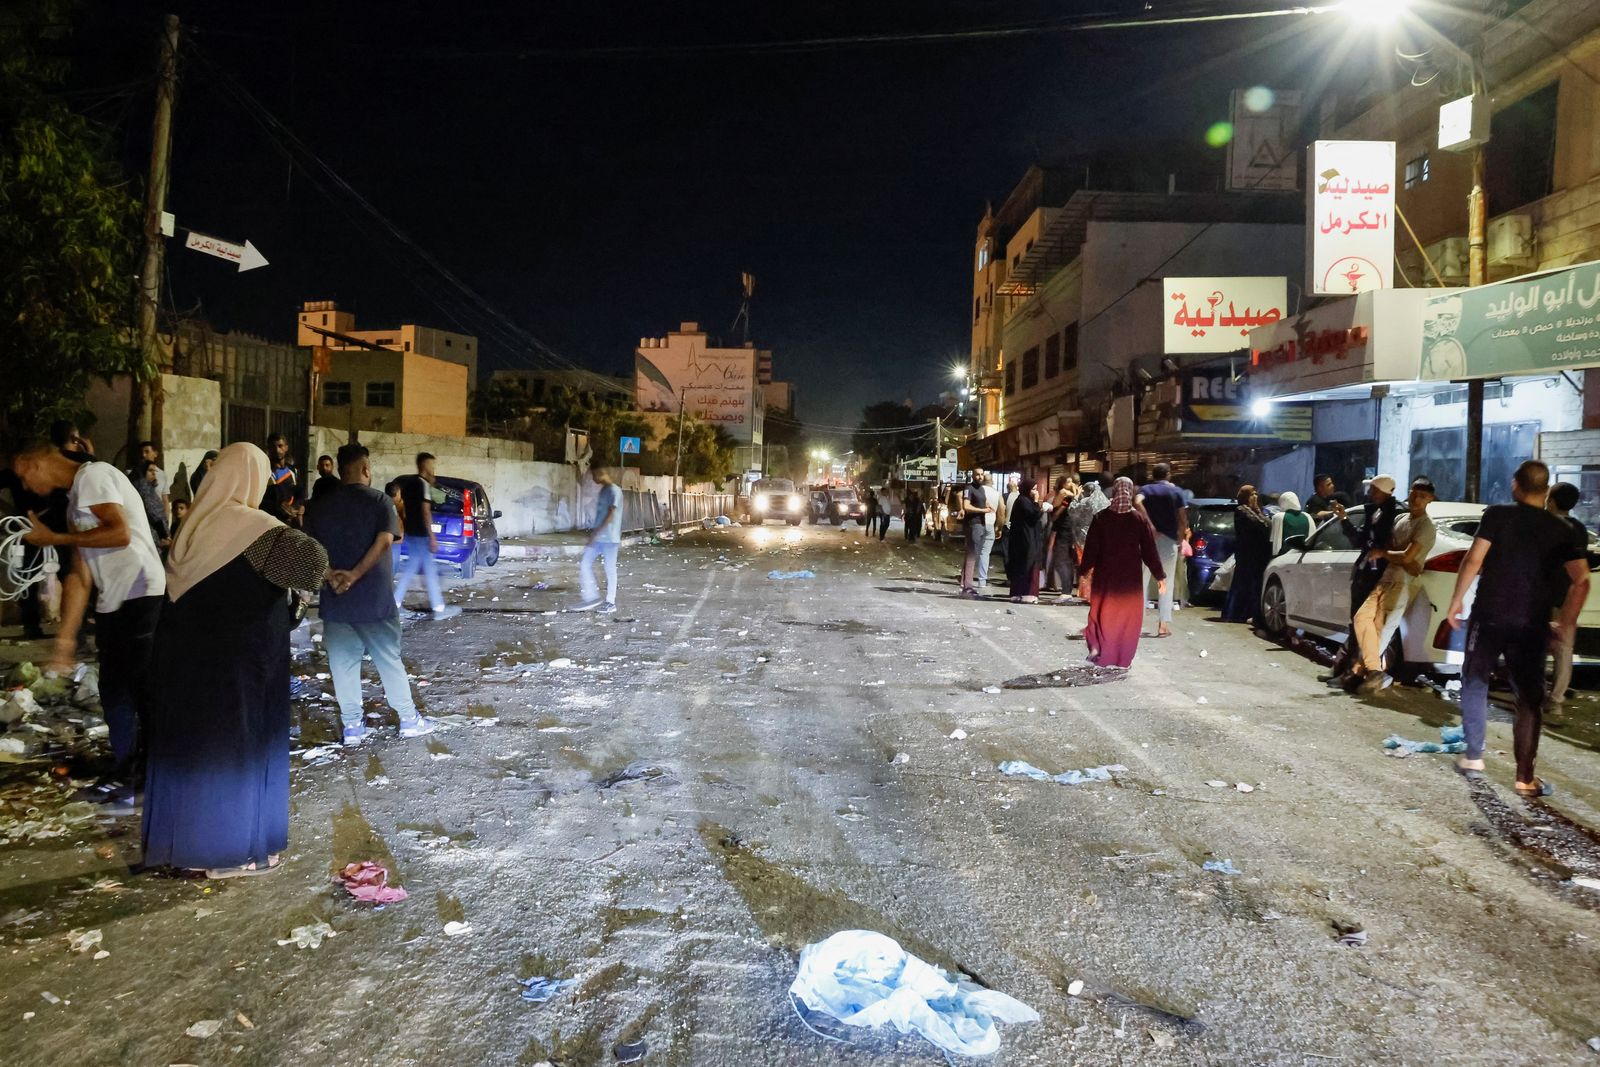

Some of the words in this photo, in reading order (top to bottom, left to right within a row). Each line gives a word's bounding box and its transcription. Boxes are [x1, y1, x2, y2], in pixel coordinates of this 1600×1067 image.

[1318, 177, 1390, 200] صيدلي
[1320, 210, 1387, 235] الكرمل
[1485, 284, 1541, 322] الوليد
[1543, 271, 1577, 313] أبو
[1171, 291, 1281, 337] صيدلية
[1529, 322, 1554, 335] حمص
